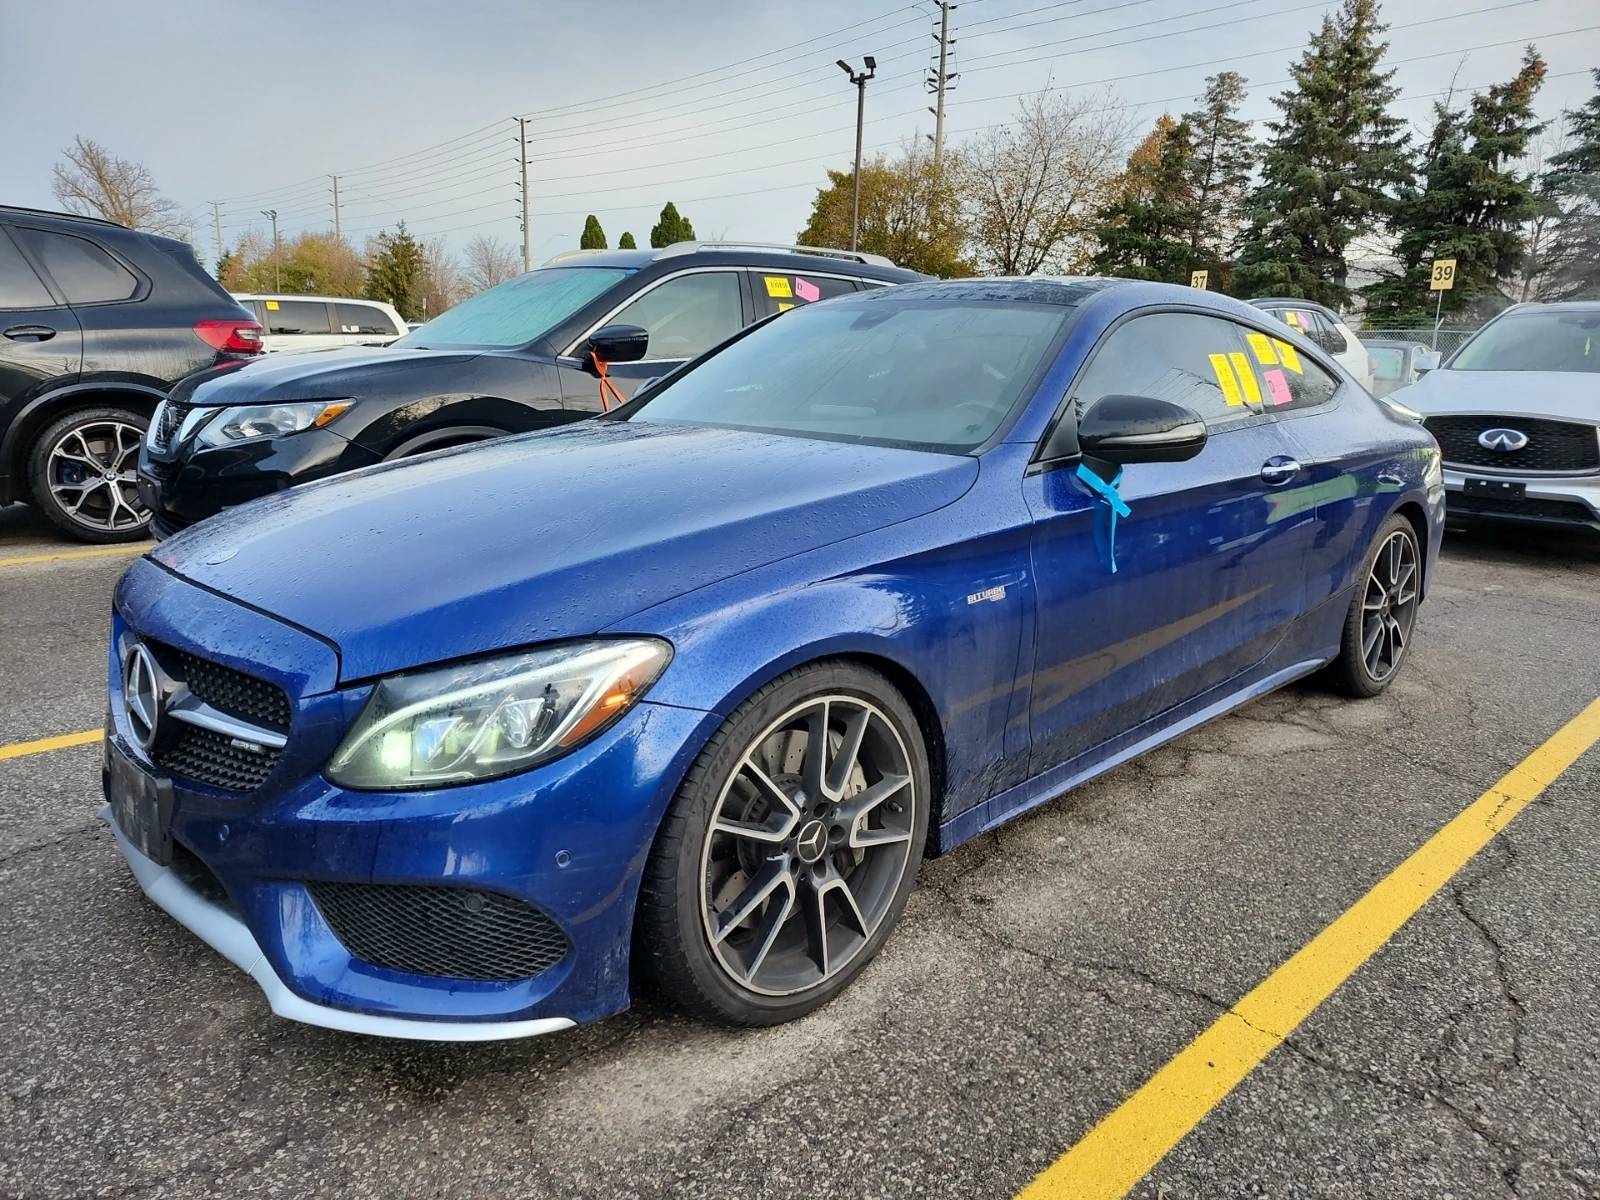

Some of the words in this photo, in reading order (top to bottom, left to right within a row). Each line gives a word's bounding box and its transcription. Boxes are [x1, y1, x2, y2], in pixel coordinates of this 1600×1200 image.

[1434, 266, 1453, 281] 39
[1193, 276, 1206, 288] 37
[967, 585, 1005, 605] BITURBO
